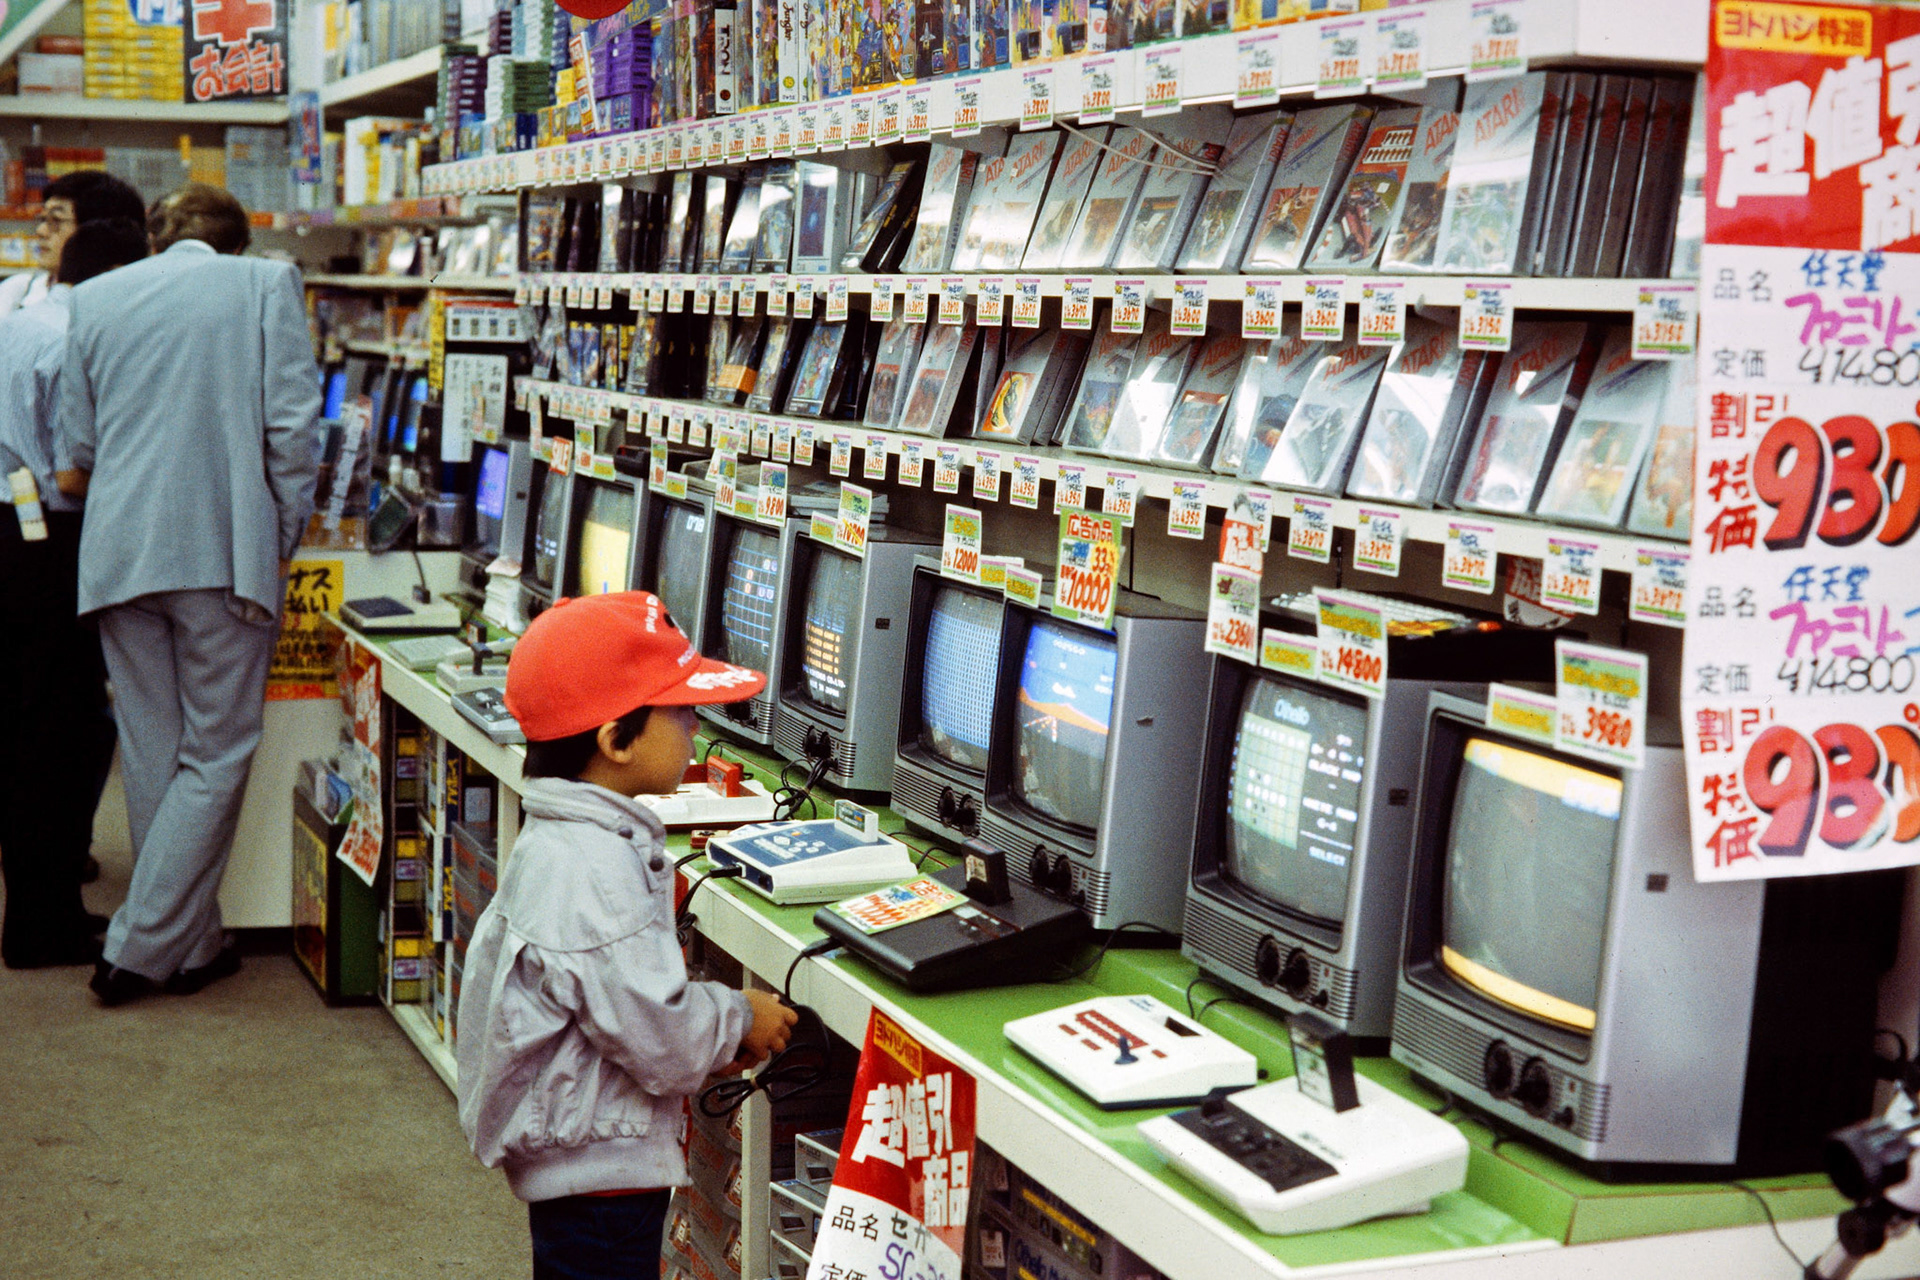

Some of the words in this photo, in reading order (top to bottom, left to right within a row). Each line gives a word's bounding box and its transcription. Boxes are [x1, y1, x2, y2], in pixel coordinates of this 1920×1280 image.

[190, 40, 284, 101] お会計
[1475, 82, 1521, 148] ATARI
[1713, 267, 1772, 302] 品名
[1801, 248, 1887, 292] 任天堂
[1122, 306, 1140, 322] 3670
[1182, 308, 1201, 324] 3600
[1254, 310, 1275, 326] 3600
[1712, 348, 1767, 379] 定価
[765, 496, 784, 518] 9800
[1113, 499, 1131, 515] 4350
[1180, 508, 1199, 525] 4350
[1067, 513, 1113, 543] 広告の品
[952, 547, 978, 574] 12000
[1067, 569, 1112, 614] 10000
[1699, 585, 1756, 619] 品名
[1783, 564, 1871, 603] 任天堂
[1337, 646, 1382, 684] 14800
[1696, 664, 1750, 694] 定価
[851, 1071, 953, 1169] 超値引
[922, 1150, 969, 1227] 商品
[831, 1204, 879, 1242] 品名
